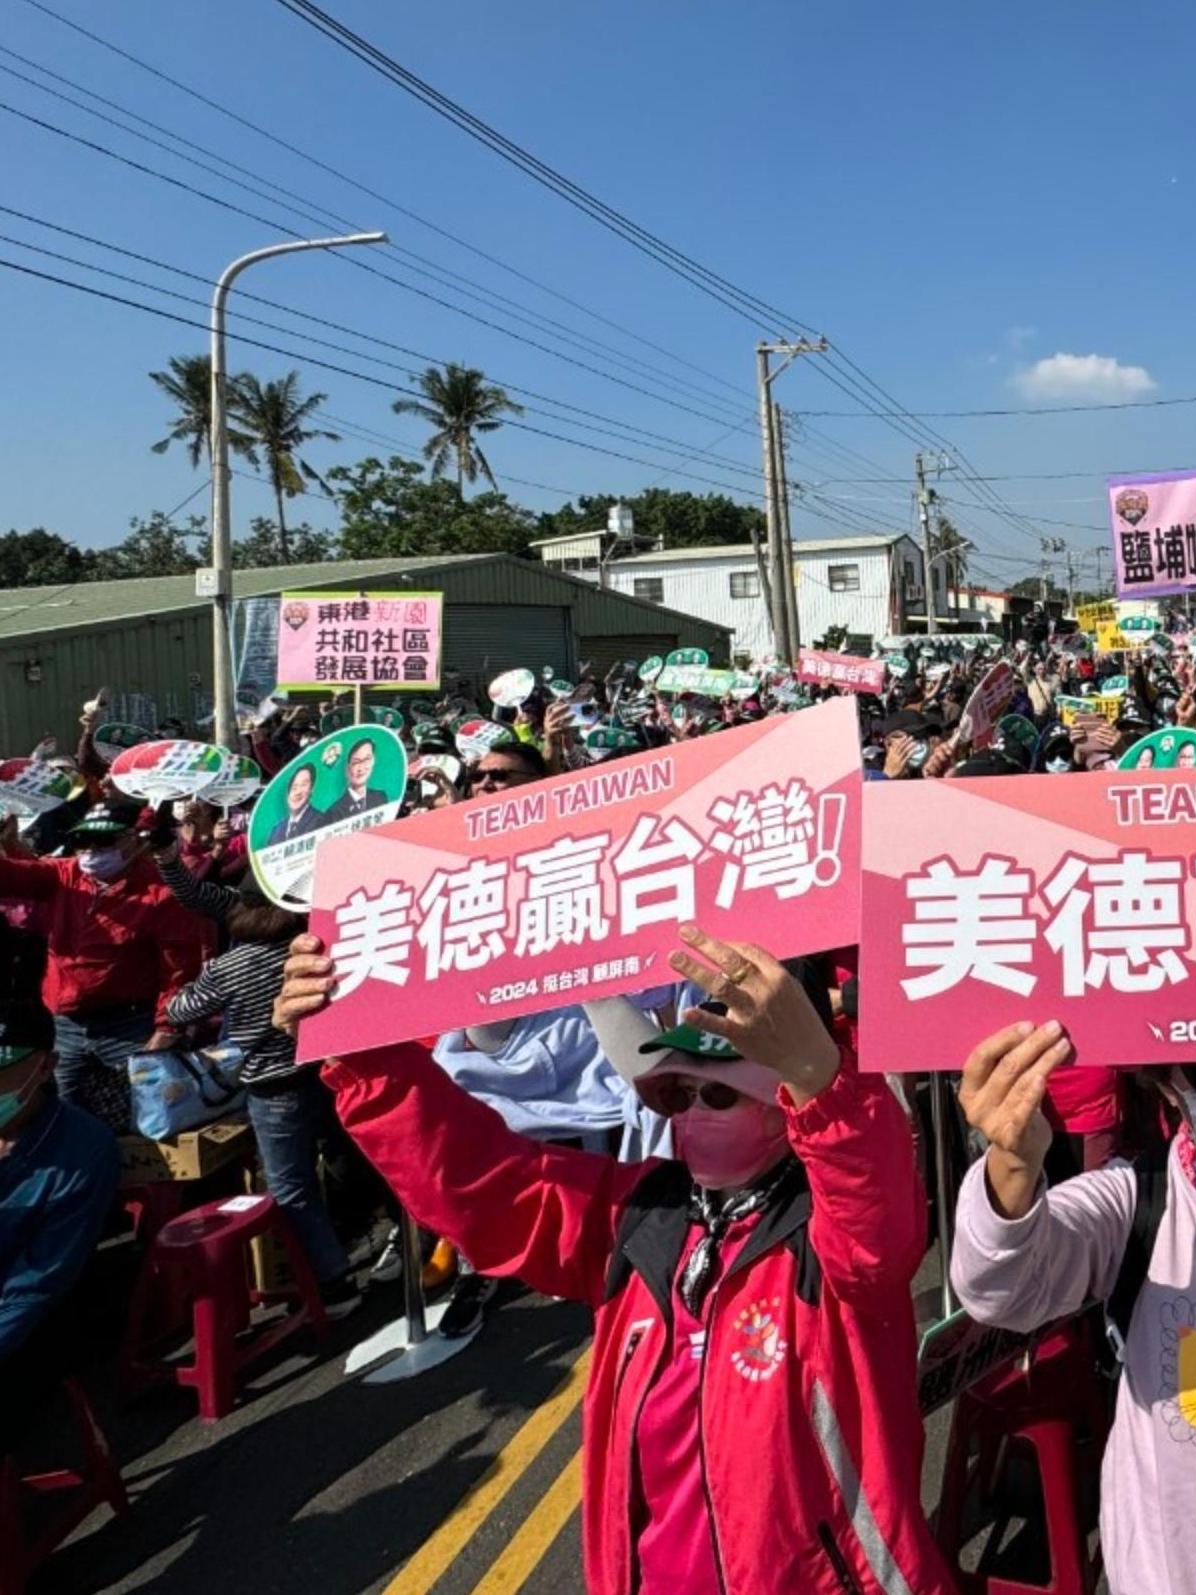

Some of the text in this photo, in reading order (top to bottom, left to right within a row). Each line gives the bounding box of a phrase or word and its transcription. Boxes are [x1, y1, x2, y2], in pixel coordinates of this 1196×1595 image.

[315, 628, 431, 653] 共和社區
[315, 655, 429, 680] 發展協會
[467, 758, 674, 839] TEAM TAIWAN
[329, 780, 847, 1000] 美德贏台灣!
[489, 955, 640, 1005] 2024 挺台灣 顧屏南
